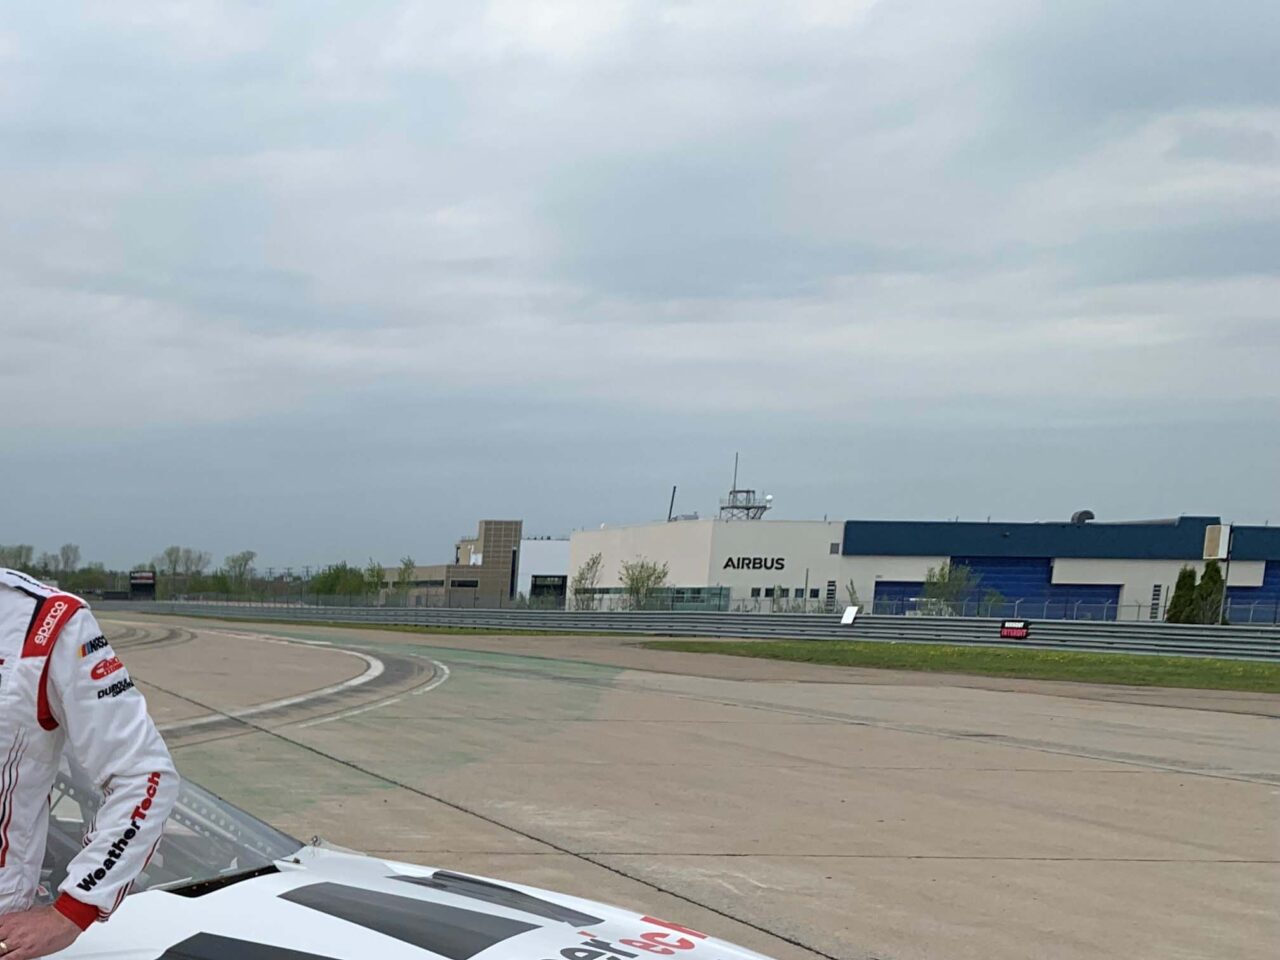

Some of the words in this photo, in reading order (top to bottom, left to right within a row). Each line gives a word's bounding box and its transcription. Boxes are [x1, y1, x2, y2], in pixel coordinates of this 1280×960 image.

[723, 556, 785, 570] AIRBUS
[34, 600, 66, 645] sparco
[76, 772, 161, 892] WeatherTech
